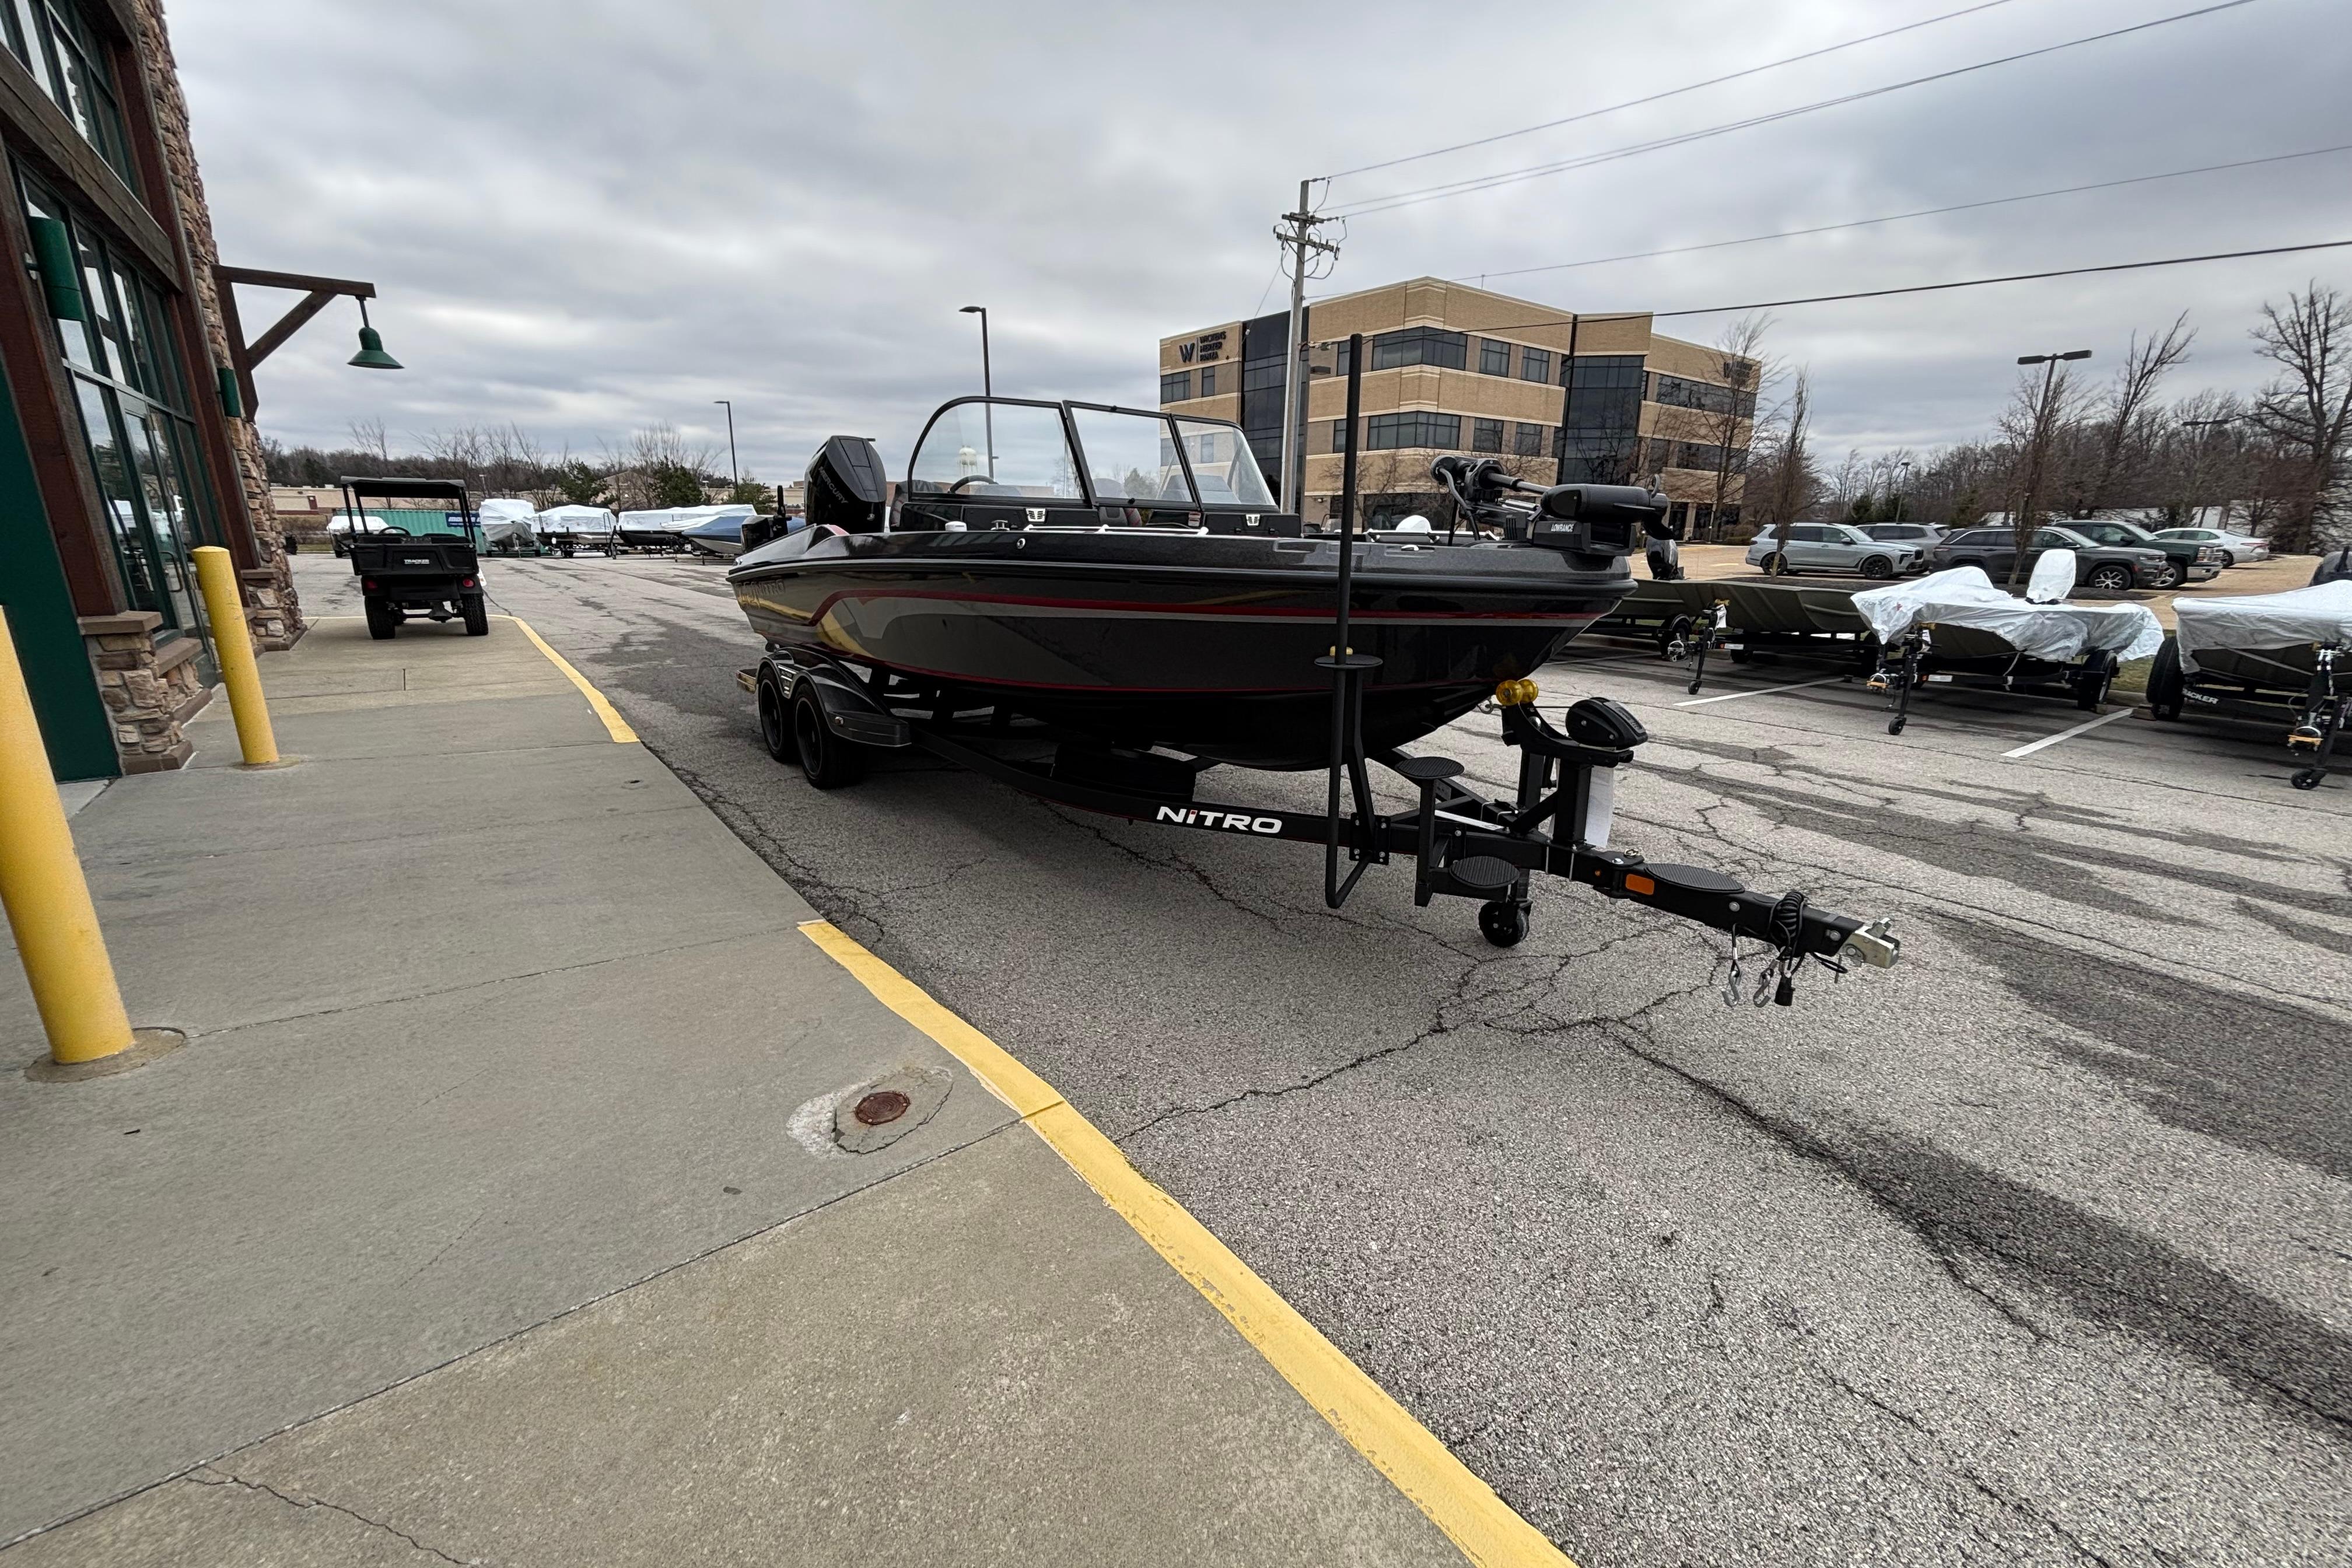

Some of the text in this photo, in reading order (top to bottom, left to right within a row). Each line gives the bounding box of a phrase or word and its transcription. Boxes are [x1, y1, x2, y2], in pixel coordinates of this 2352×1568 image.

[1179, 342, 1195, 363] W
[818, 466, 849, 503] MERCURY
[1550, 524, 1574, 532] LOWRANCE
[2182, 688, 2219, 704] RACKER
